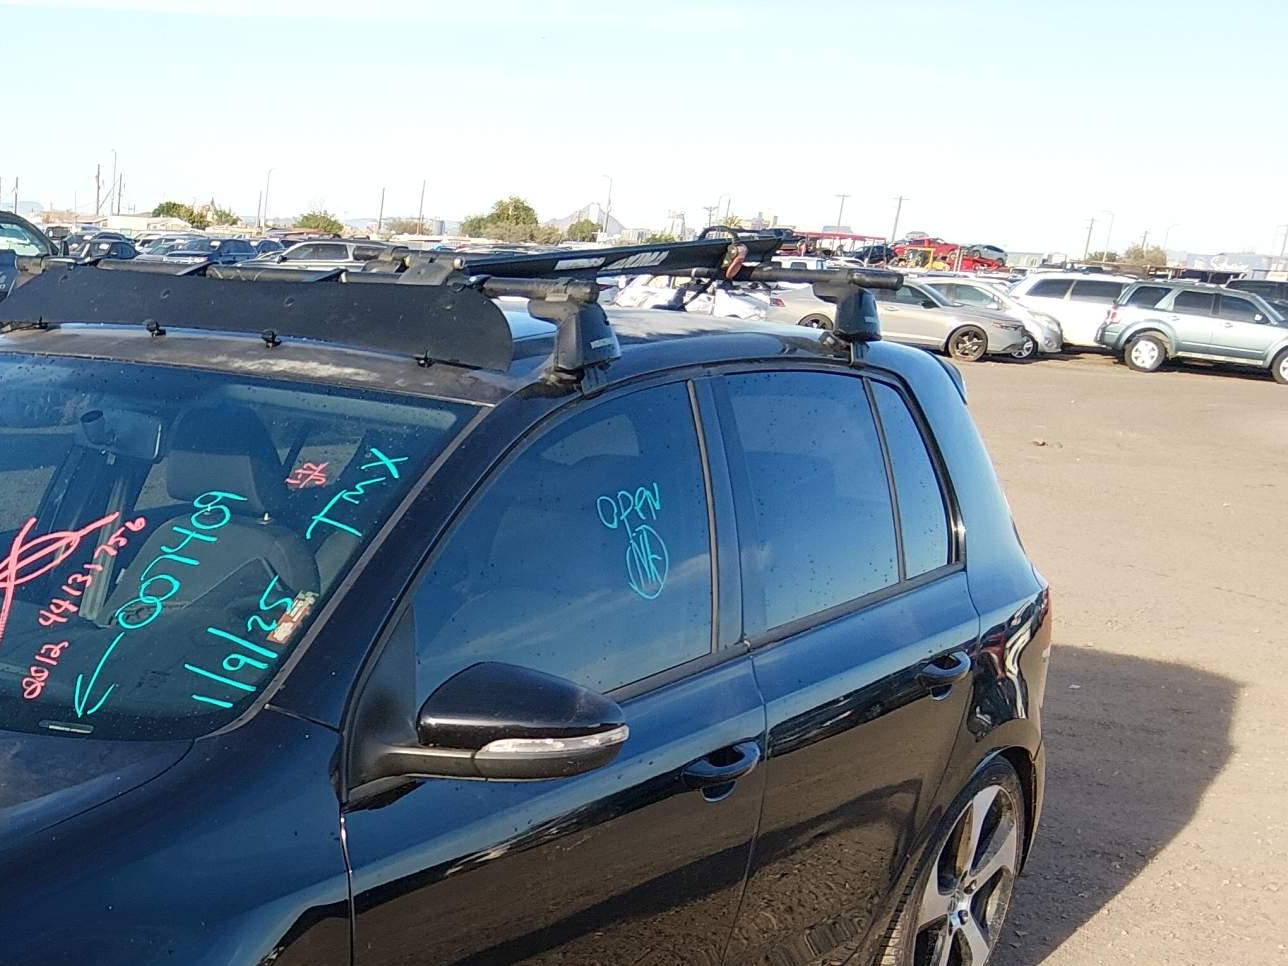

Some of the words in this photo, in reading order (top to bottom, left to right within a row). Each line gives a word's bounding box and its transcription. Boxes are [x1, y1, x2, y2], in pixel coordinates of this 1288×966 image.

[37, 516, 147, 627] 44131756
[114, 490, 249, 630] 007409
[183, 574, 295, 709] 1/9/25
